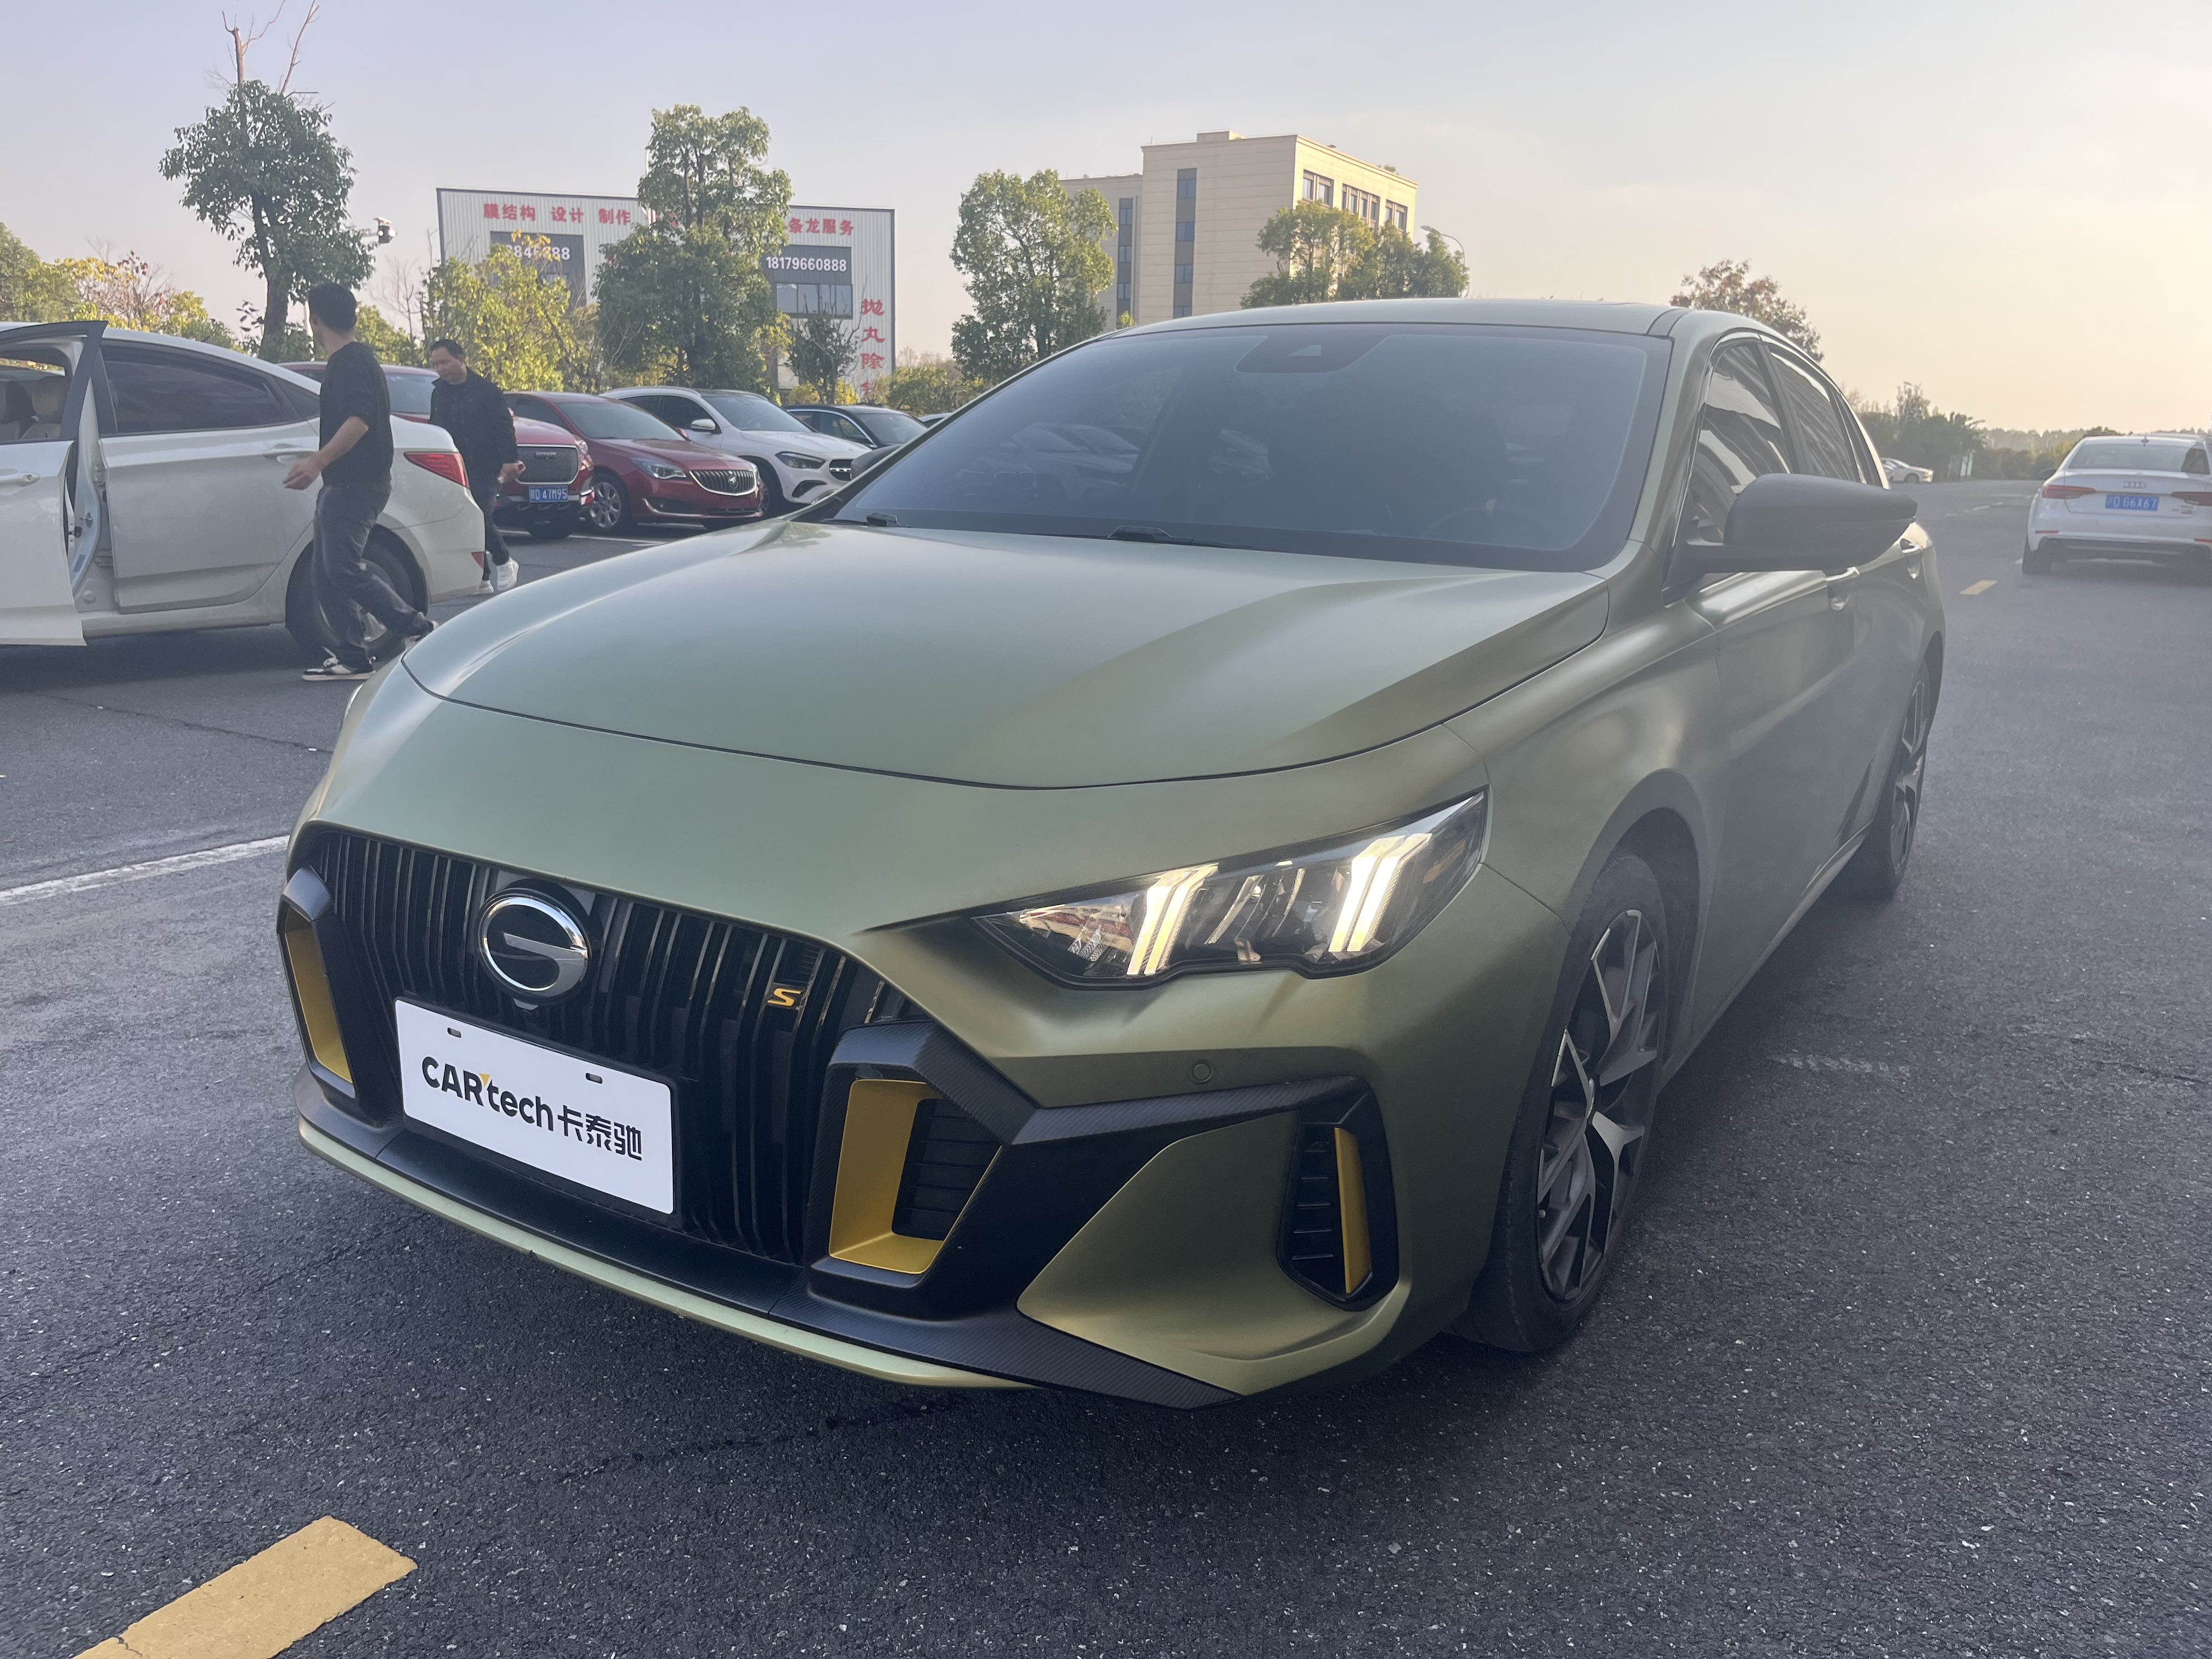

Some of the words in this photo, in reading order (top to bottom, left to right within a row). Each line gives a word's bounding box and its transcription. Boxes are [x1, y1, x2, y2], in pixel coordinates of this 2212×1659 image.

[484, 203, 535, 221] 膜结构
[551, 206, 584, 224] 设计
[599, 208, 631, 225] 制作
[766, 256, 847, 272] 18179660888
[767, 988, 802, 1007] S
[422, 1056, 554, 1132] CARtech
[557, 1104, 642, 1161] 卡泰驰
